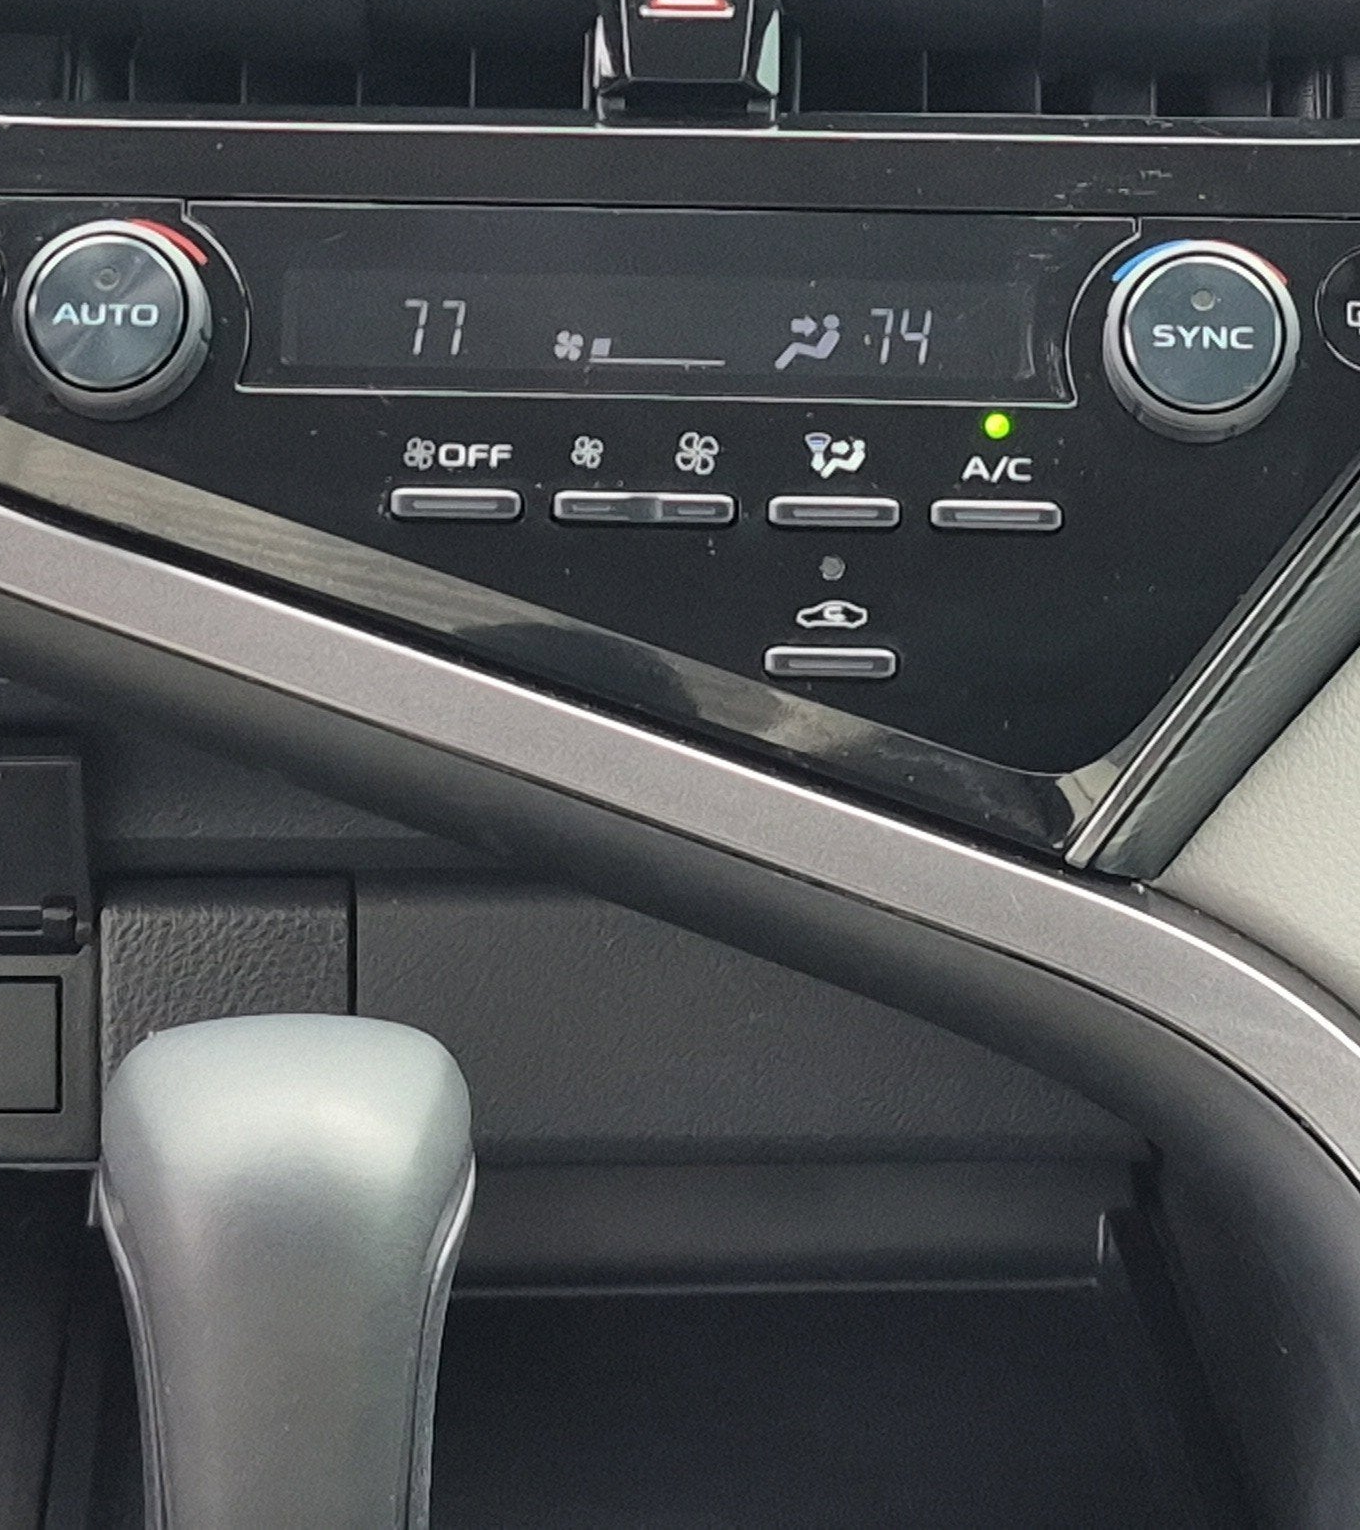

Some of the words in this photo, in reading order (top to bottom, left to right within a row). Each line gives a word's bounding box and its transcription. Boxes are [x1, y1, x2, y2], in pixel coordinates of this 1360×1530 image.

[52, 302, 159, 327] AUTO
[404, 298, 467, 356] 77
[1152, 324, 1254, 350] SYNC
[438, 442, 513, 468] OFF
[961, 456, 1033, 483] A/C
